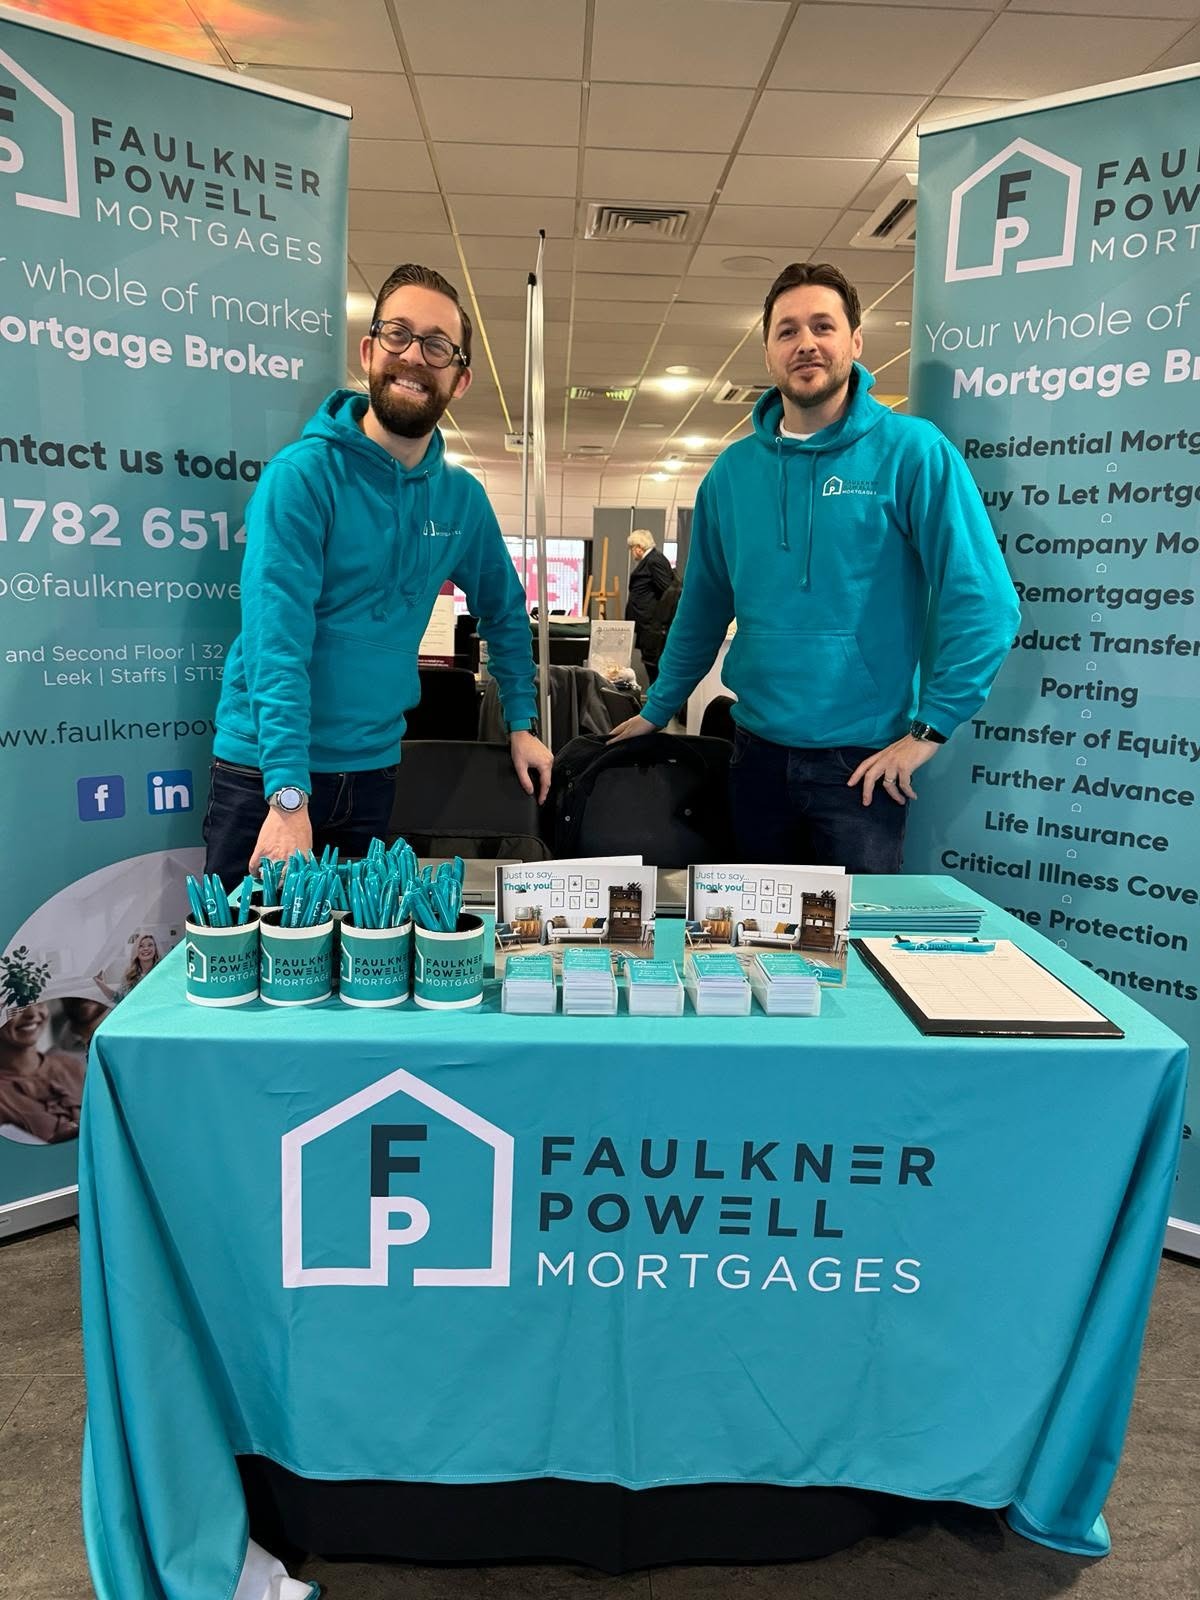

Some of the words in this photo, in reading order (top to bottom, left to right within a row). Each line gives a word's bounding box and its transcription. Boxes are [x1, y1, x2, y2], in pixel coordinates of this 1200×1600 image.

[92, 117, 321, 197] FAULKNER
[1097, 146, 1200, 190] FAU
[94, 157, 277, 222] POWELL
[1093, 183, 1200, 226] POW
[96, 197, 322, 265] MORTGAGES
[1090, 223, 1200, 263] MORT
[22, 258, 147, 306] whole
[161, 282, 199, 314] of
[211, 294, 333, 337] market
[925, 321, 1000, 352] Your
[1013, 302, 1132, 344] whole
[1146, 292, 1192, 330] of
[0, 315, 172, 369] ortgage
[185, 334, 304, 380] Broker
[952, 361, 1150, 401] Mortgage
[964, 430, 1113, 459] Residential
[120, 447, 163, 475] us
[174, 447, 268, 484] toda
[978, 485, 1014, 511] uy
[1021, 484, 1050, 506] To
[1058, 483, 1100, 505] Let
[1015, 533, 1148, 560] Company
[1156, 531, 1199, 554] Mo
[1014, 581, 1195, 610] Remortgages
[5, 645, 45, 663] and
[52, 643, 128, 663] Second
[135, 643, 185, 661] Floor
[202, 643, 225, 659] 32
[44, 668, 92, 686] Leek
[111, 667, 167, 684] Staffs
[1040, 677, 1139, 708] Porting
[971, 719, 1076, 747] Transfer
[1083, 729, 1111, 750] of
[1117, 730, 1200, 762] Equity
[971, 764, 1065, 792] Further
[1071, 774, 1195, 806] Advance
[985, 810, 1029, 834] Life
[1036, 816, 1169, 852] Insurance
[503, 871, 522, 880] Just
[525, 871, 535, 879] to
[503, 882, 532, 891] Thank
[695, 871, 714, 880] Just
[716, 872, 727, 880] to
[695, 882, 723, 891] Thank
[941, 850, 1031, 880] Critical
[1039, 862, 1119, 892] Illness
[1127, 875, 1200, 905] Cove
[1049, 909, 1189, 951] Protection
[274, 964, 325, 976] POWELL
[354, 964, 404, 976] POWELL
[426, 967, 475, 977] POWELL
[540, 1135, 937, 1187] FAULKNER
[538, 1192, 844, 1238] POWELL
[536, 1250, 922, 1295] MORTGAGES
